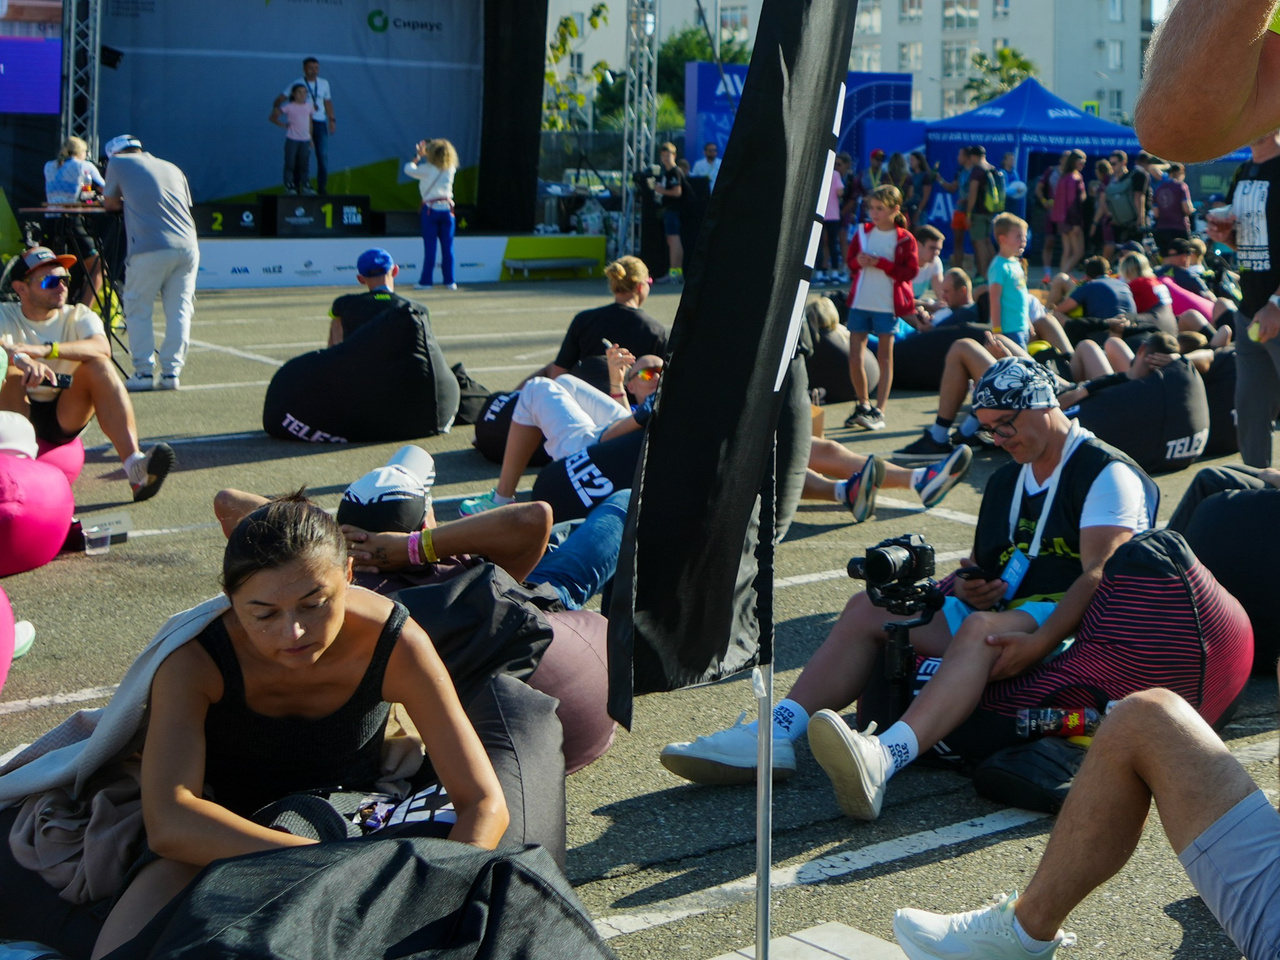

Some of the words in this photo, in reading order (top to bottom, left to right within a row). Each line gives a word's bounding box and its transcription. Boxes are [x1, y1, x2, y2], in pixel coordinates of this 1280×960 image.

[393, 18, 443, 32] Сириус
[1046, 108, 1082, 119] AVA
[212, 212, 223, 231] 2
[321, 203, 333, 229] 1
[343, 213, 362, 225] STAR
[230, 266, 250, 274] AVA
[1252, 260, 1271, 271] 226
[777, 705, 795, 718] ЭТО
[901, 742, 910, 762] ЭТО
